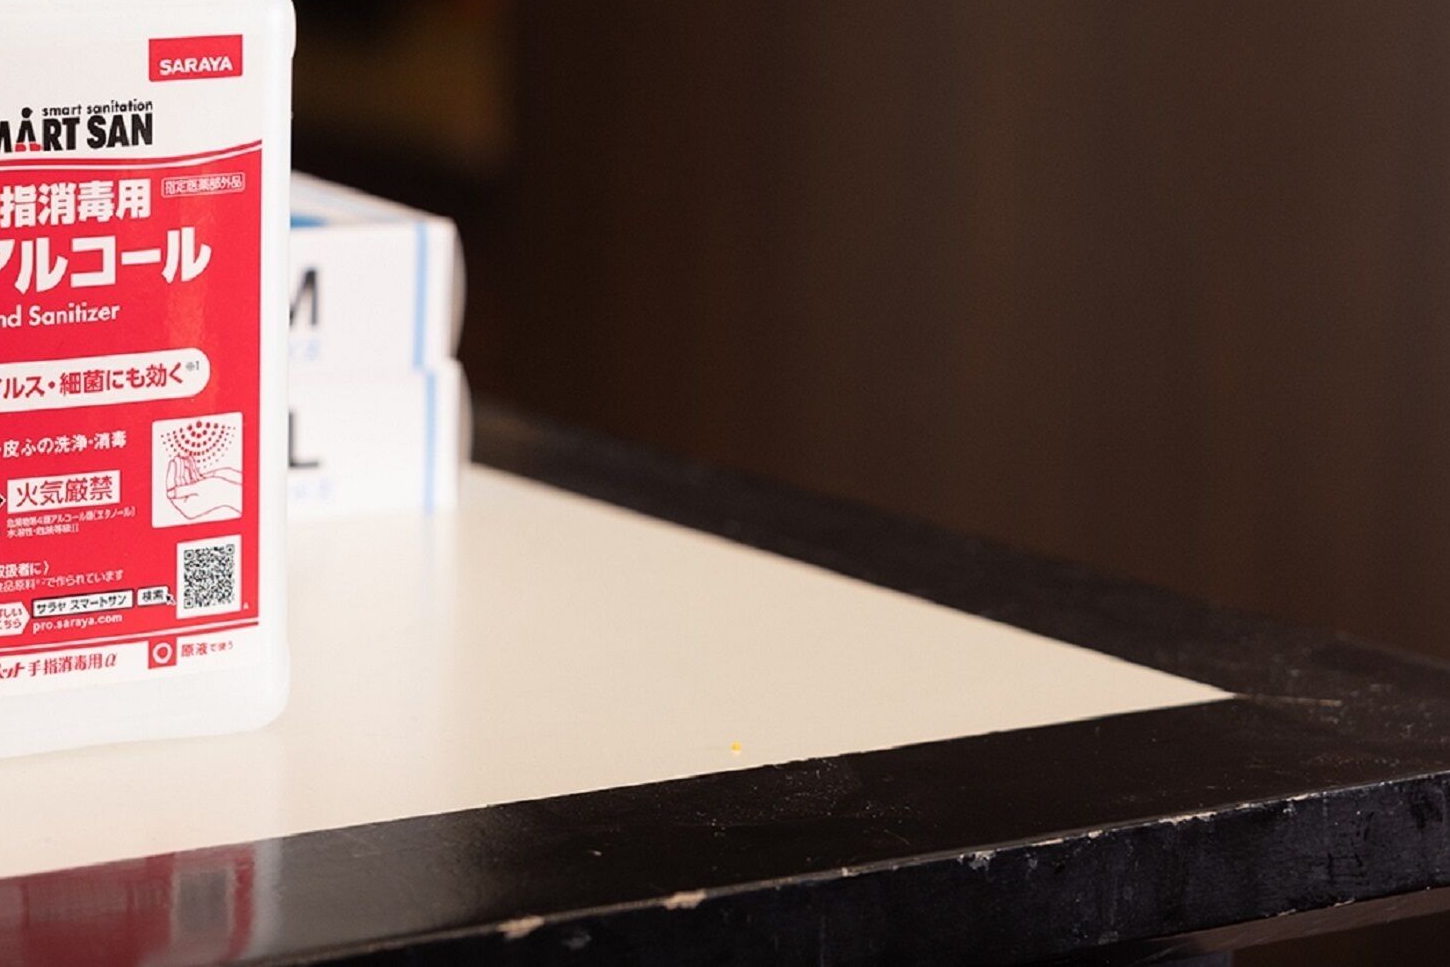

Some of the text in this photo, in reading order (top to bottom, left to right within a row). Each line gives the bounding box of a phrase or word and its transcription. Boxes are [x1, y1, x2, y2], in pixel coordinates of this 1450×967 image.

[159, 56, 233, 76] SARAYA
[42, 100, 153, 117] smart sanitation
[87, 113, 154, 149] SAN
[28, 301, 121, 327] Sanitizer
[16, 474, 114, 508] 火気厳禁
[33, 613, 123, 634] pro.saraya.com
